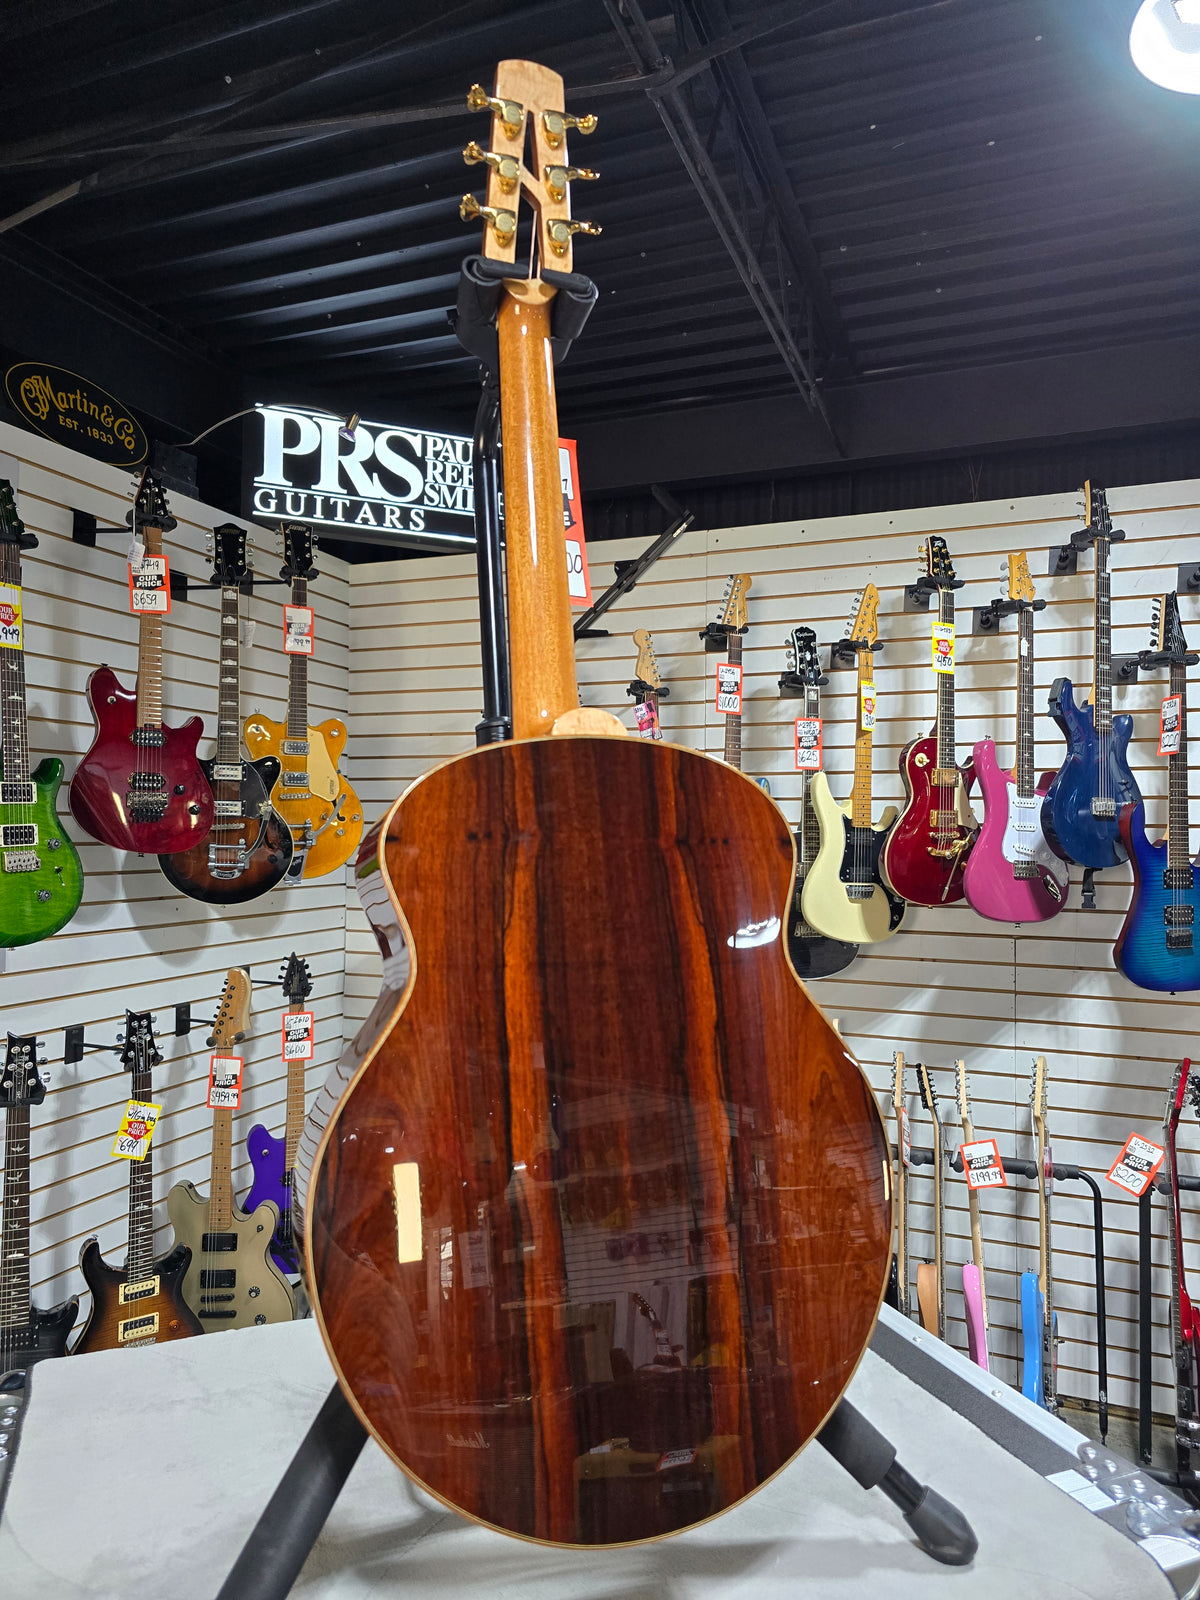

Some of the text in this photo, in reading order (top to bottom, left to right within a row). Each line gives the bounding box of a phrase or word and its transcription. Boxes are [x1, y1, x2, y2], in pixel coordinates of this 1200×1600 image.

[100, 404, 114, 428] &
[87, 426, 114, 445] 1833
[253, 407, 424, 503] PRS
[425, 435, 474, 464] PAU
[425, 459, 474, 489] REE
[424, 482, 475, 513] SMI
[253, 488, 426, 532] GUITARS
[133, 593, 157, 606] $659
[0, 613, 15, 621] RICE
[0, 626, 20, 642] ,949
[1163, 720, 1179, 731] PRICE
[1165, 715, 1177, 724] OUR
[287, 1032, 309, 1041] PRICE
[289, 1028, 305, 1036] OUR
[127, 1127, 147, 1137] PRICE
[131, 1122, 146, 1130] OUR
[970, 1160, 995, 1170] PRICE
[971, 1156, 989, 1164] OUR
[1123, 1158, 1150, 1172] PRICE
[1129, 1155, 1148, 1166] OUR
[1112, 1166, 1143, 1188] $200
